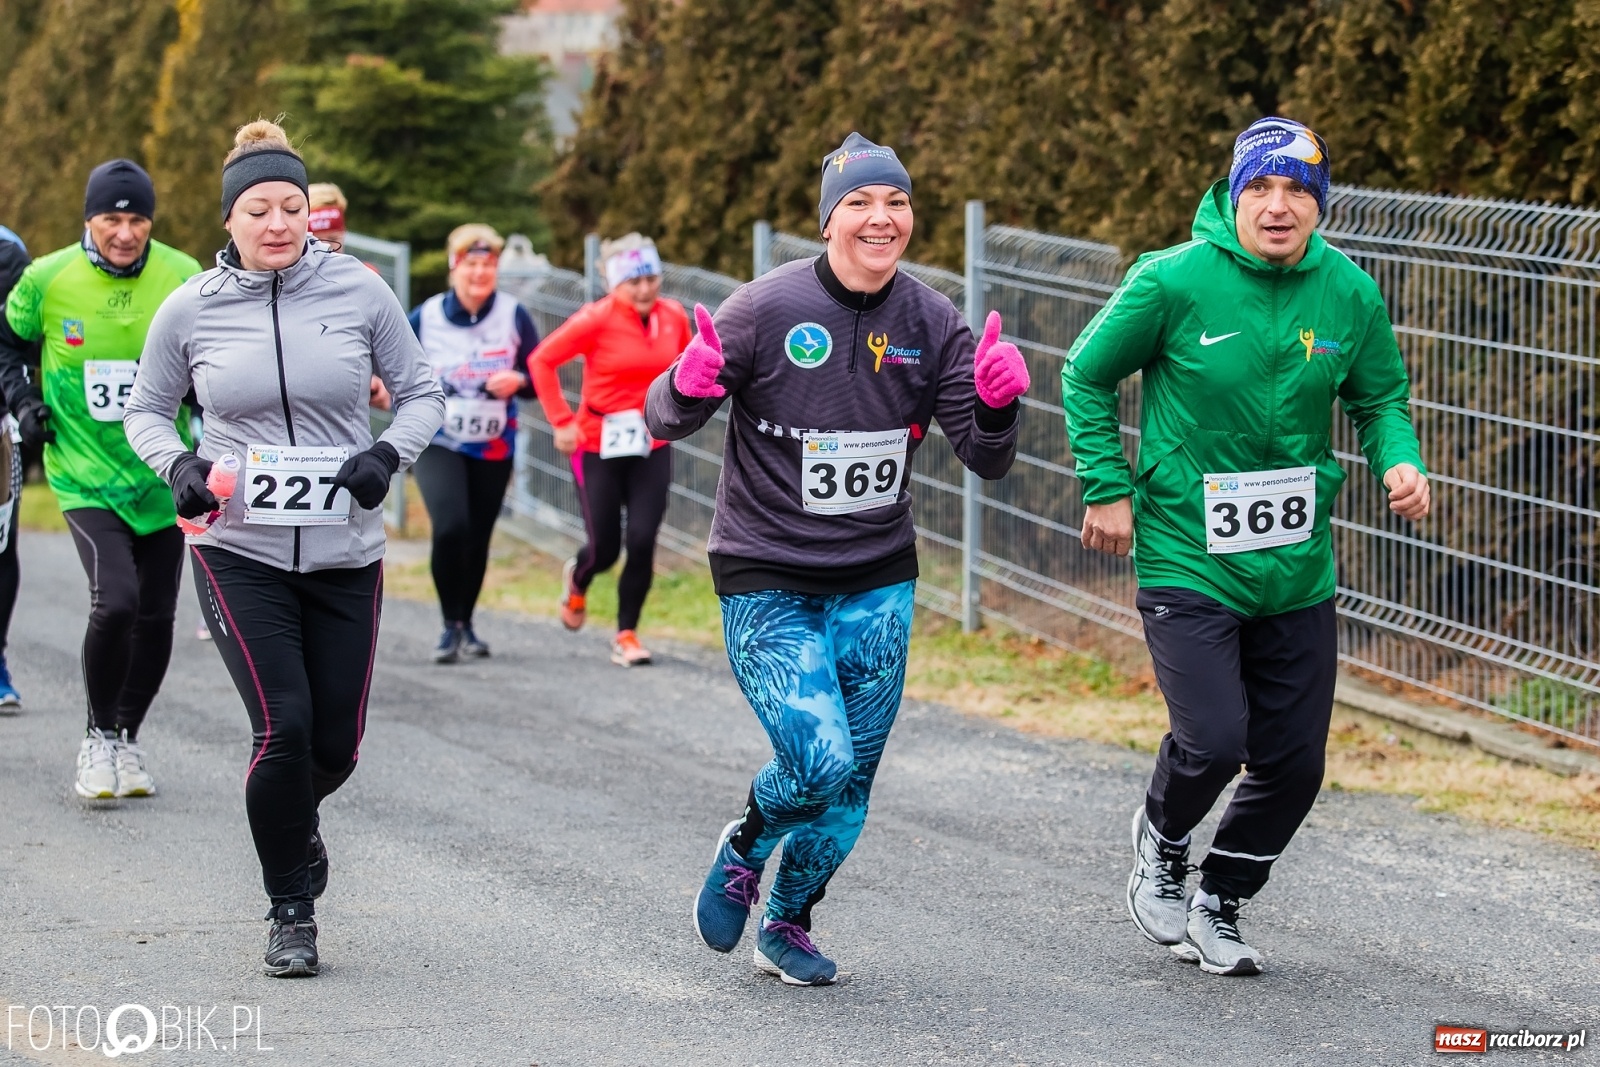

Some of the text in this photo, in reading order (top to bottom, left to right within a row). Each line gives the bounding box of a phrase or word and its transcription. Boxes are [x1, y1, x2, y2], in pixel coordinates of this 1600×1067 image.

[885, 345, 921, 357] Dystans
[453, 415, 499, 436] 358
[843, 436, 904, 450] www.personalbest.pl
[283, 455, 346, 463] www.personalbest.pl
[808, 458, 898, 499] 369
[1243, 475, 1311, 488] www.personalbest.pl
[250, 474, 341, 511] 227
[1212, 496, 1308, 538] 368
